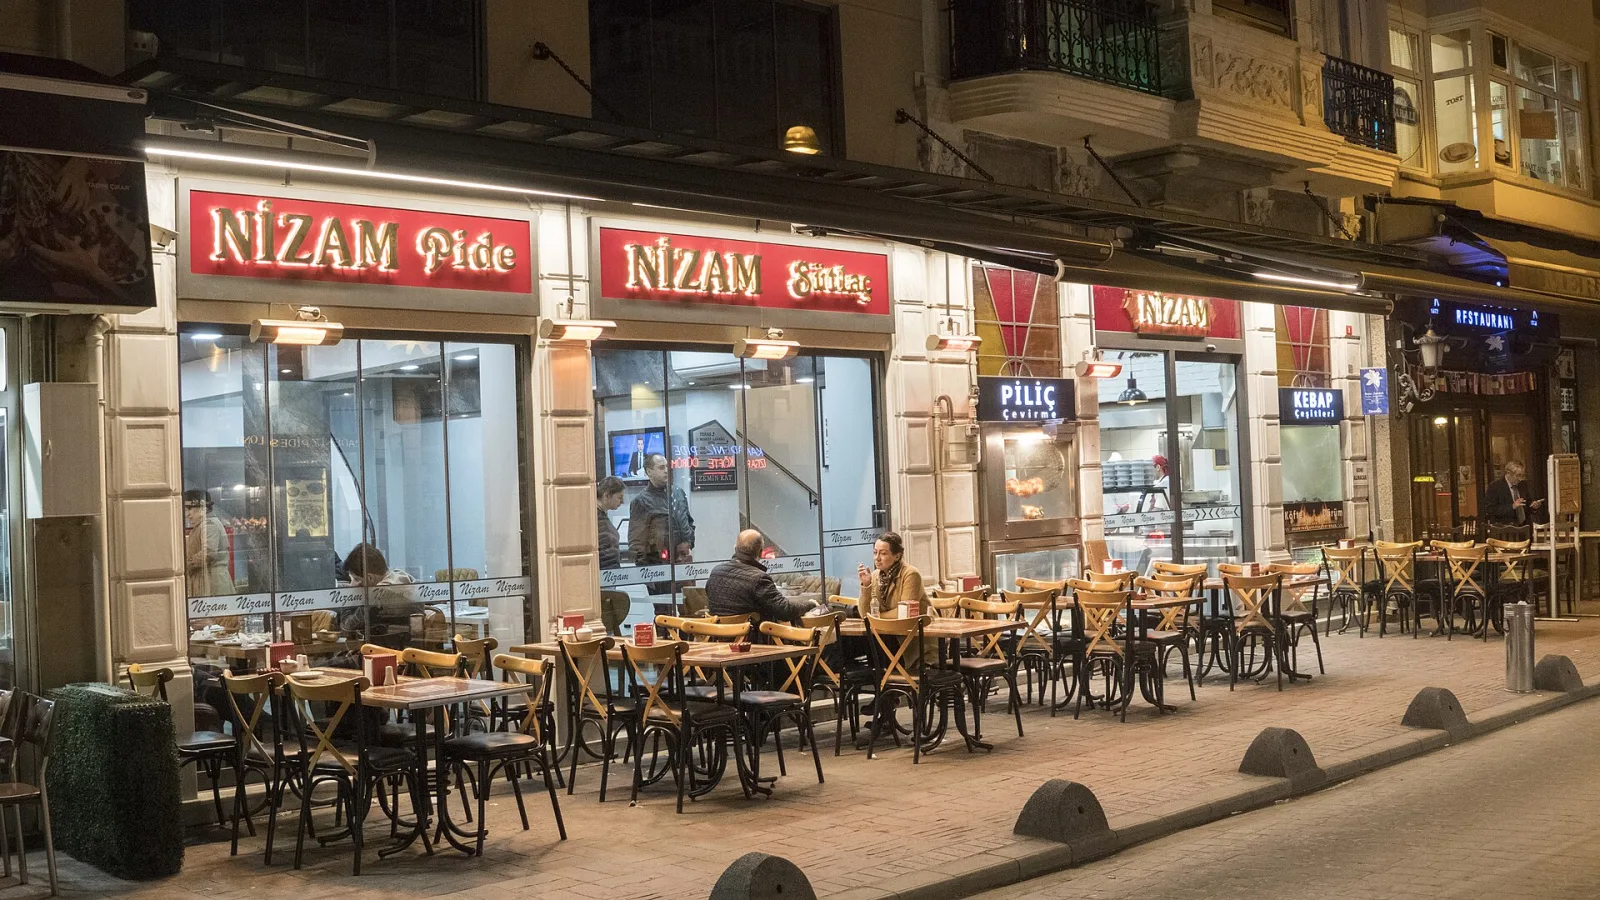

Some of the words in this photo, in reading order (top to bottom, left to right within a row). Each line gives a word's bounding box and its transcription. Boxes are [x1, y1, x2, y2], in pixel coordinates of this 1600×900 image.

[1445, 95, 1464, 106] TOST
[210, 200, 400, 271] NİZAM
[416, 226, 518, 274] Pide
[625, 238, 762, 297] NİZAM
[788, 260, 872, 305] Sütlaç
[1136, 291, 1209, 328] NİZAM
[1001, 380, 1056, 412] PİLİÇ
[1293, 391, 1334, 408] KEBAP
[1002, 409, 1057, 420] Çevirme
[1294, 409, 1335, 419] Çeşitleri
[831, 533, 852, 545] Nizam
[603, 570, 628, 584] Nizam
[640, 567, 665, 581] Nizam
[685, 565, 709, 578] Nizam
[793, 558, 815, 569] Nizam
[191, 599, 228, 616] Nizam
[236, 596, 270, 612] Nizam
[280, 593, 314, 610] Nizam
[329, 590, 362, 606] Nizam
[418, 585, 449, 600] Nizam
[460, 583, 490, 598] Nizam
[495, 580, 525, 595] Nizam
